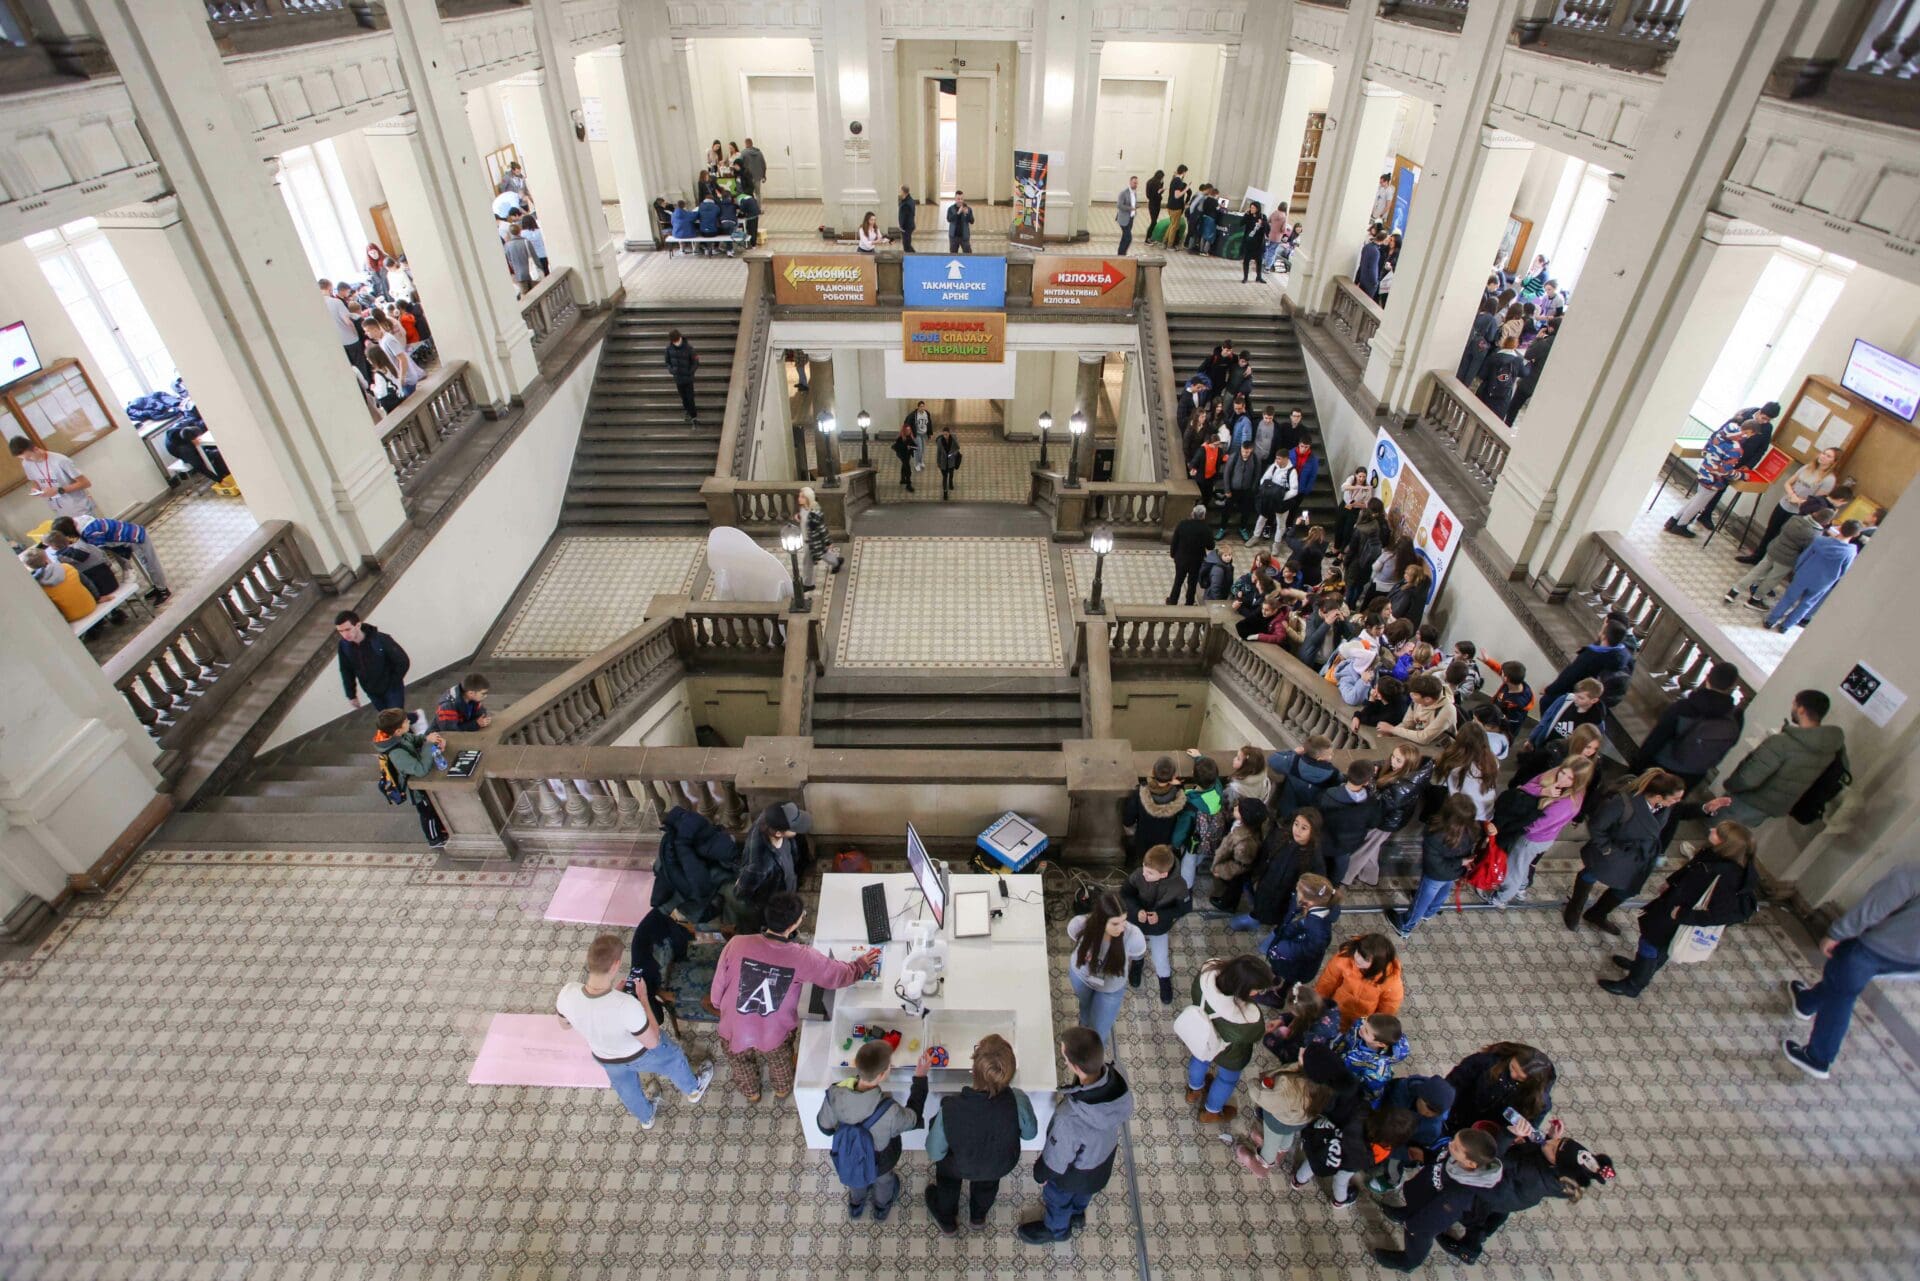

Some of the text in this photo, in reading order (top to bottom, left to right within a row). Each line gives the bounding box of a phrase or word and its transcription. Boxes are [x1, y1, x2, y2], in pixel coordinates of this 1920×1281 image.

[793, 269, 859, 280] РАДИОНИЦЕ
[1057, 273, 1112, 284] ИЗЛОЖБА
[815, 284, 864, 292] РАДИОНИЦЕ
[921, 281, 987, 290] ТАКМИЧАРСКЕ
[823, 293, 864, 301] РОБОТИКЕ
[942, 292, 969, 301] АРЕНЕ
[1043, 288, 1099, 297] ИНТЕРАКТИВНА
[1043, 297, 1081, 305] ИЗЛОЖБА
[911, 333, 993, 344] КОЈЕ СПАЈАЈУ
[921, 345, 988, 356] ГЕНЕРАЦИЈЕ
